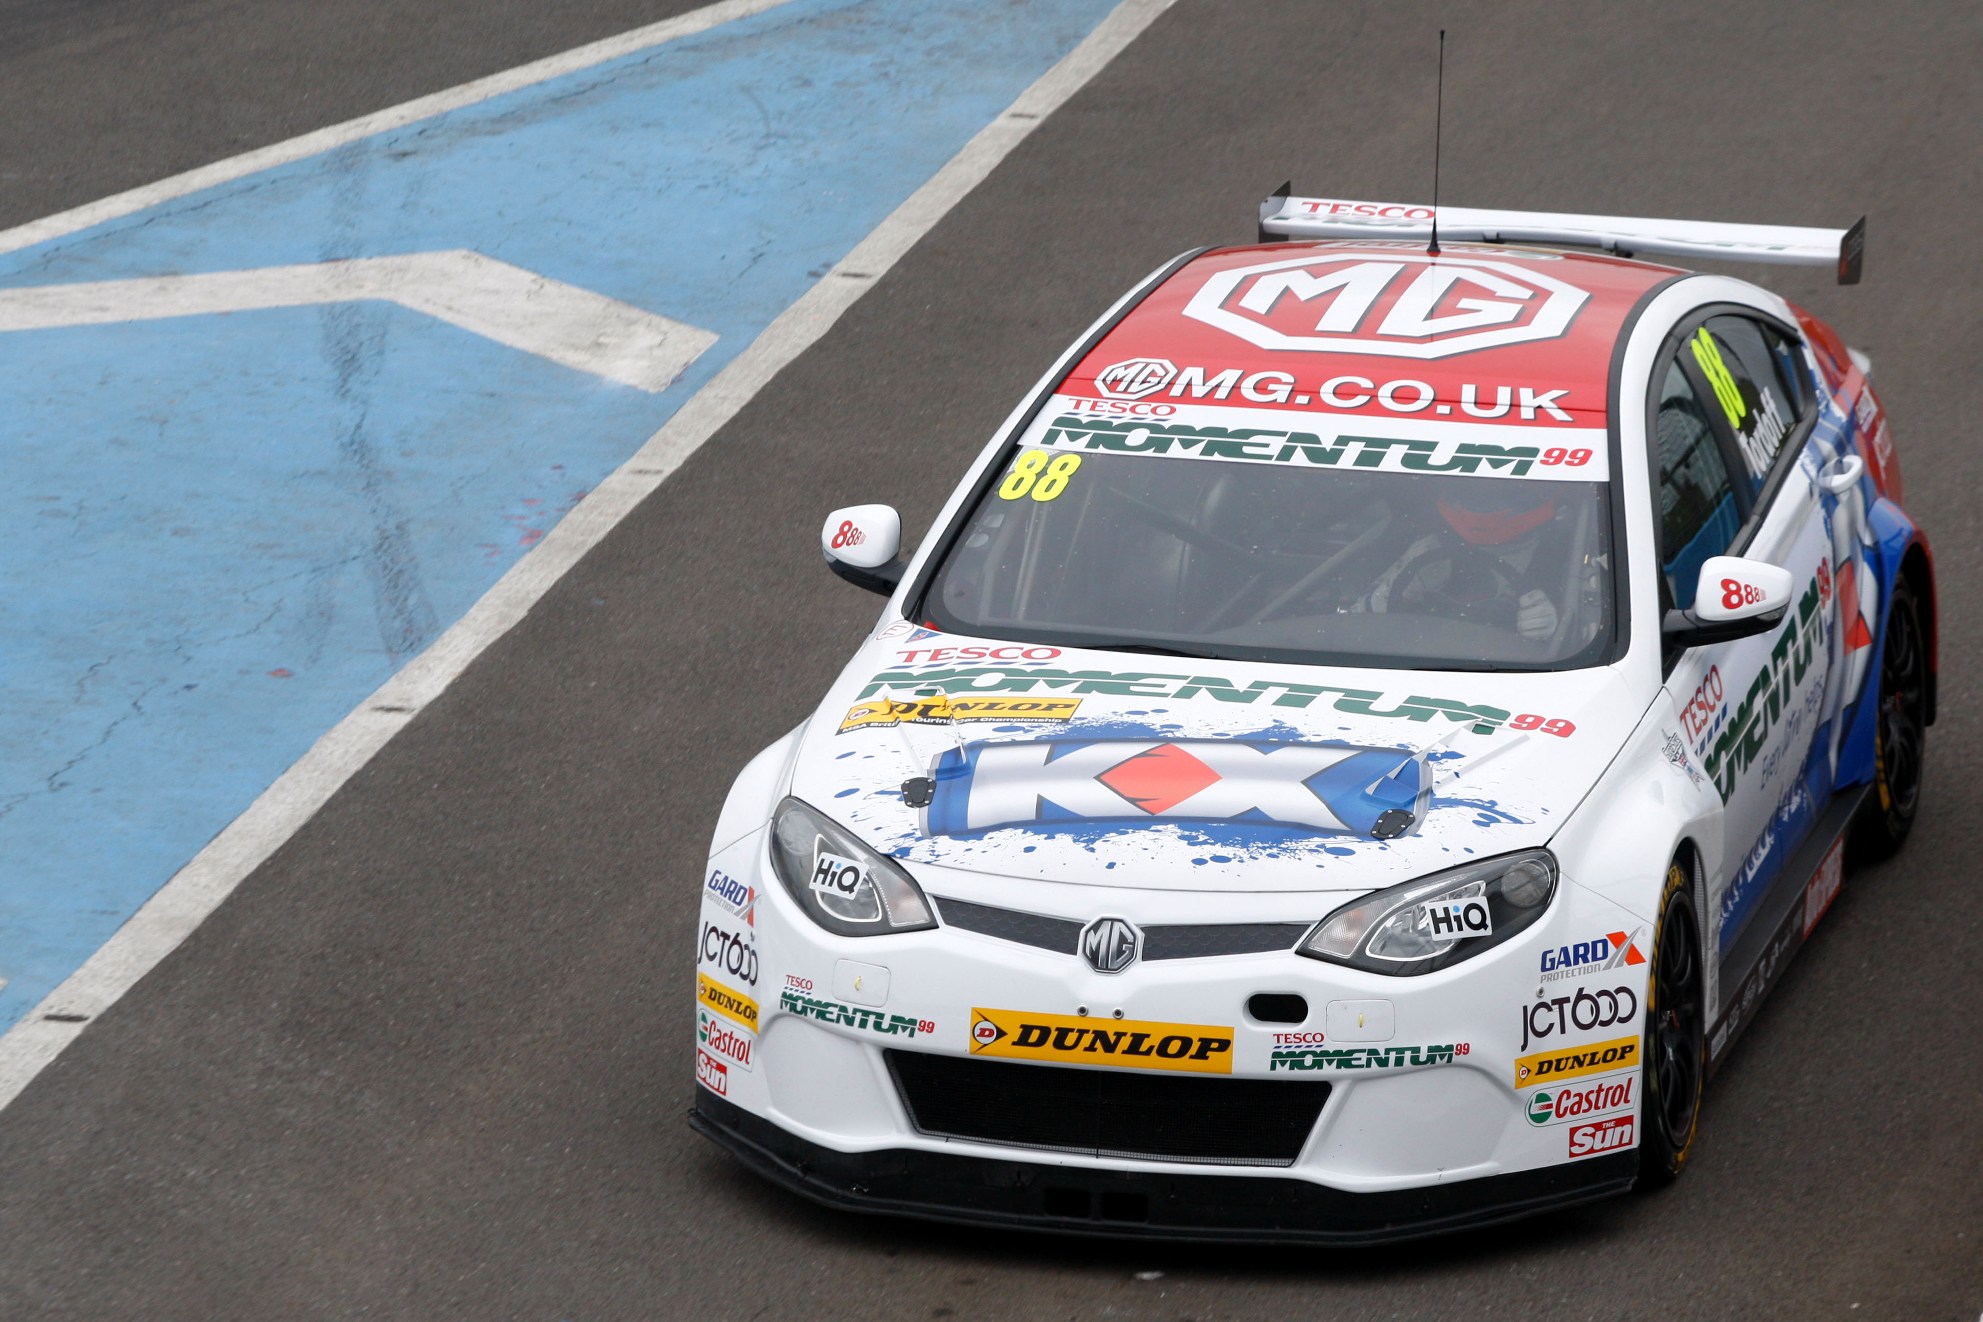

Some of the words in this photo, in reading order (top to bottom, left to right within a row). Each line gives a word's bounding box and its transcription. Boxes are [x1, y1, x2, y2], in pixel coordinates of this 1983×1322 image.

[1302, 202, 1435, 219] TESCO
[1238, 260, 1535, 337] MG
[1170, 367, 1574, 421] MG.CO.UK
[1691, 327, 1746, 429] 88
[1069, 399, 1177, 416] TESCO
[1040, 416, 1540, 477] MOMENTUM
[1539, 447, 1594, 467] 99
[998, 449, 1082, 502] 88
[896, 647, 1062, 663] TESCO
[854, 668, 1511, 735] MOMENTUM
[1508, 714, 1577, 738] 99
[1680, 664, 1723, 745] TESCO
[812, 858, 860, 894] HiQ
[1430, 902, 1489, 934] HiQ
[698, 921, 758, 986] JCT600
[1085, 920, 1135, 969] MG
[785, 975, 813, 990] TESCO
[1540, 964, 1601, 983] PROTECTION
[708, 987, 758, 1023] DUNLOP
[780, 991, 918, 1038] MOMENTUM
[917, 1020, 936, 1034] 99
[1521, 986, 1637, 1052] JCT600
[708, 1020, 751, 1066] Castrol
[1011, 1024, 1232, 1061] DUNLOP
[1270, 1044, 1455, 1071] MOMENTUM
[1455, 1043, 1470, 1055] 99
[1273, 1032, 1324, 1044] TESCO
[698, 1053, 727, 1093] Sun
[1534, 1045, 1635, 1076] DUNLOP
[1554, 1077, 1633, 1118] Castrol
[1570, 1122, 1633, 1154] Sun
[1602, 1120, 1616, 1129] THE
